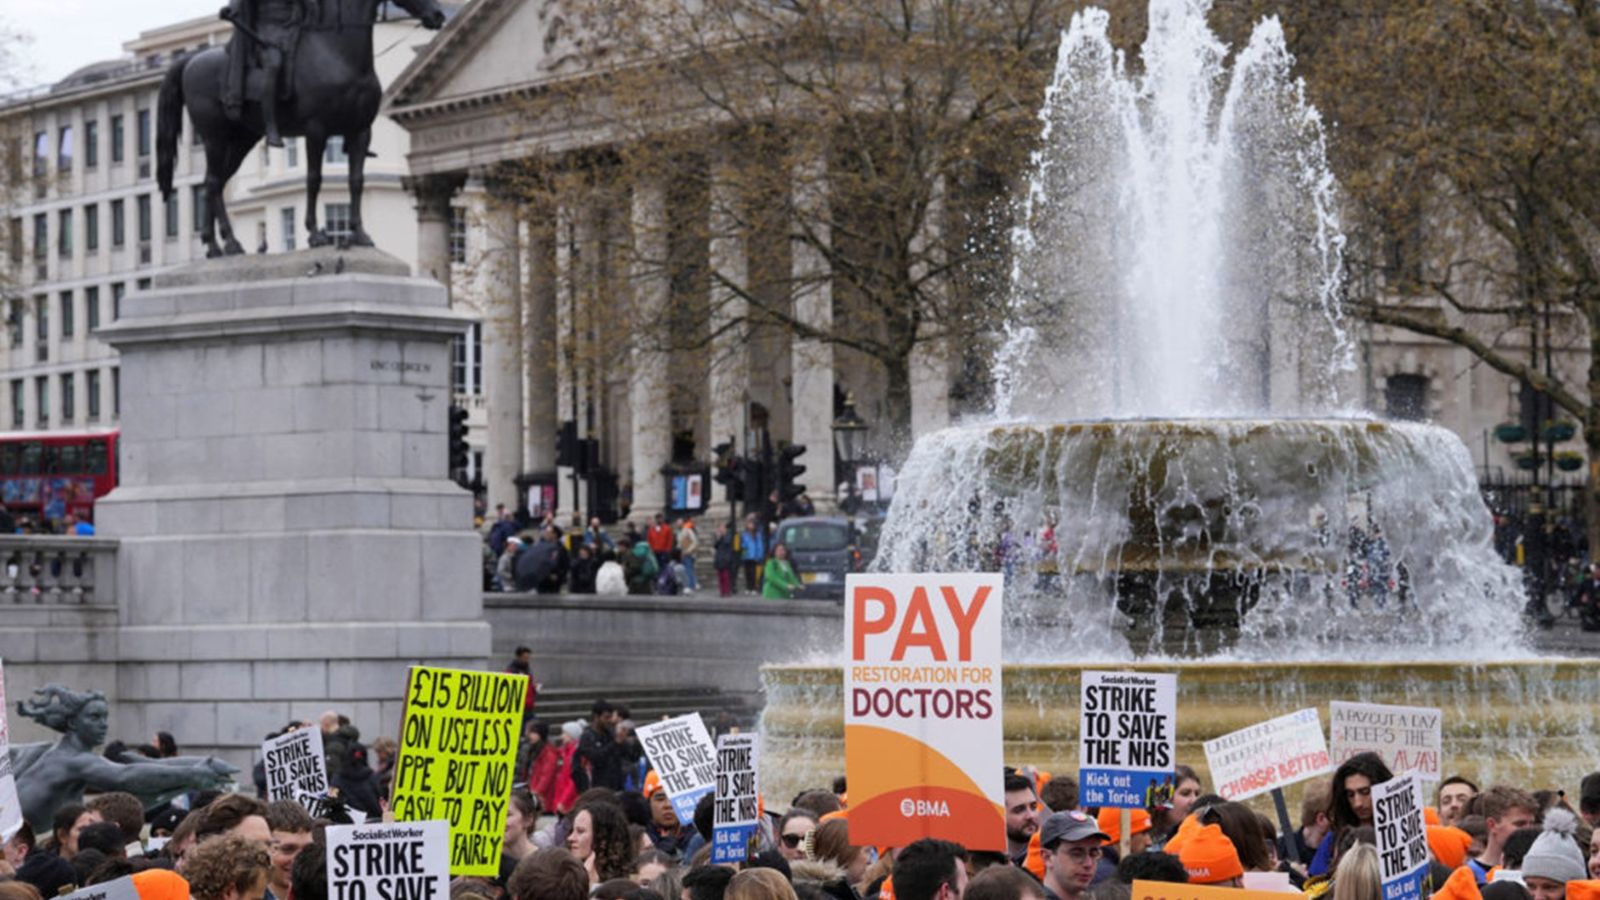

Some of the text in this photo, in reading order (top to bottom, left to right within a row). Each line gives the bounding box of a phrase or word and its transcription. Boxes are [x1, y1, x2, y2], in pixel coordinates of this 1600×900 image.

[852, 585, 993, 662] PAY
[852, 666, 992, 684] RESTORATION FOR
[410, 669, 524, 714] £15 BILLION
[852, 687, 993, 719] DOCTORS
[1085, 685, 1157, 713] STRIKE
[405, 714, 513, 756] ON USELESS
[644, 726, 698, 756] STRIKE
[1084, 712, 1167, 740] TO SAVE
[1344, 726, 1433, 748] KEEPS THE
[266, 739, 312, 769] STRIKE
[653, 743, 714, 775] TO SAVE
[716, 746, 752, 773] STRIKE
[1084, 740, 1170, 768] THE NHS
[268, 755, 322, 787] TO SAVE
[298, 773, 325, 794] NHS
[444, 759, 480, 795] BUT
[482, 761, 509, 798] NO
[662, 769, 696, 794] THE
[716, 774, 729, 799] TO
[732, 772, 755, 798] SAVE
[1086, 771, 1131, 788] Kick out
[715, 799, 736, 824] THE
[738, 796, 757, 823] NHS
[916, 799, 950, 817] BMA
[1086, 789, 1140, 805] the Tories
[1376, 785, 1416, 825] STRIKE
[393, 794, 505, 832] CASH TO PAY
[1378, 810, 1422, 851] TO SAVE
[333, 841, 425, 878] STRIKE
[451, 833, 502, 866] FAIRLY
[1381, 834, 1427, 878] THE NHS
[333, 876, 438, 900] TO SAVE
